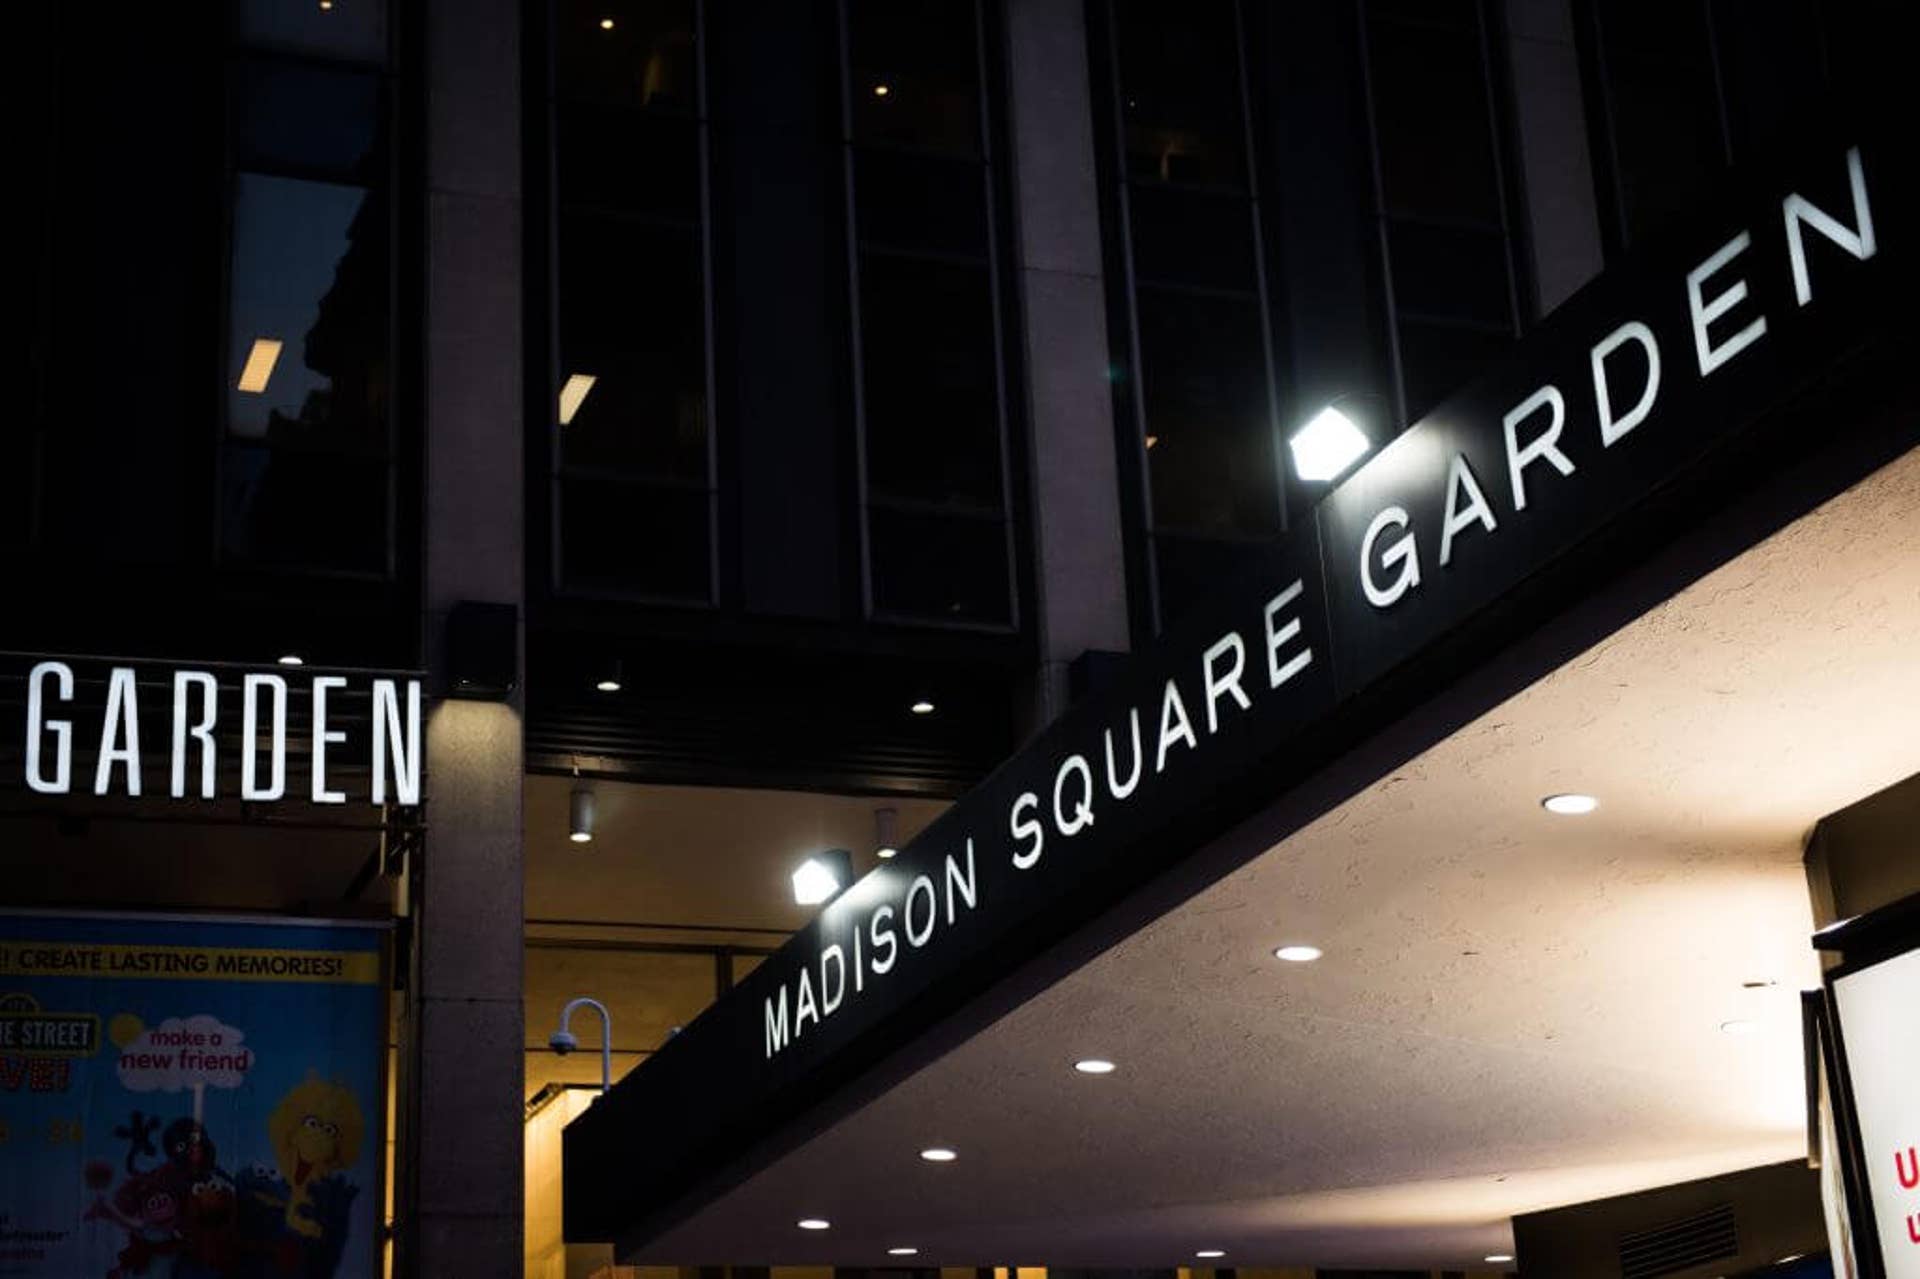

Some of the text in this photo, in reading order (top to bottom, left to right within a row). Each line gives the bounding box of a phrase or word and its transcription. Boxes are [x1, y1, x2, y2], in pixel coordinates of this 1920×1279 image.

[763, 144, 1877, 1060] MADISON SQUARE GARDEN
[25, 661, 421, 806] GARDEN
[18, 948, 101, 972] CREATE
[111, 952, 209, 974] LASTING
[216, 954, 343, 977] MEMORIES!
[21, 1021, 91, 1048] STREET
[149, 1029, 222, 1047] make a
[120, 1049, 248, 1072] new friend
